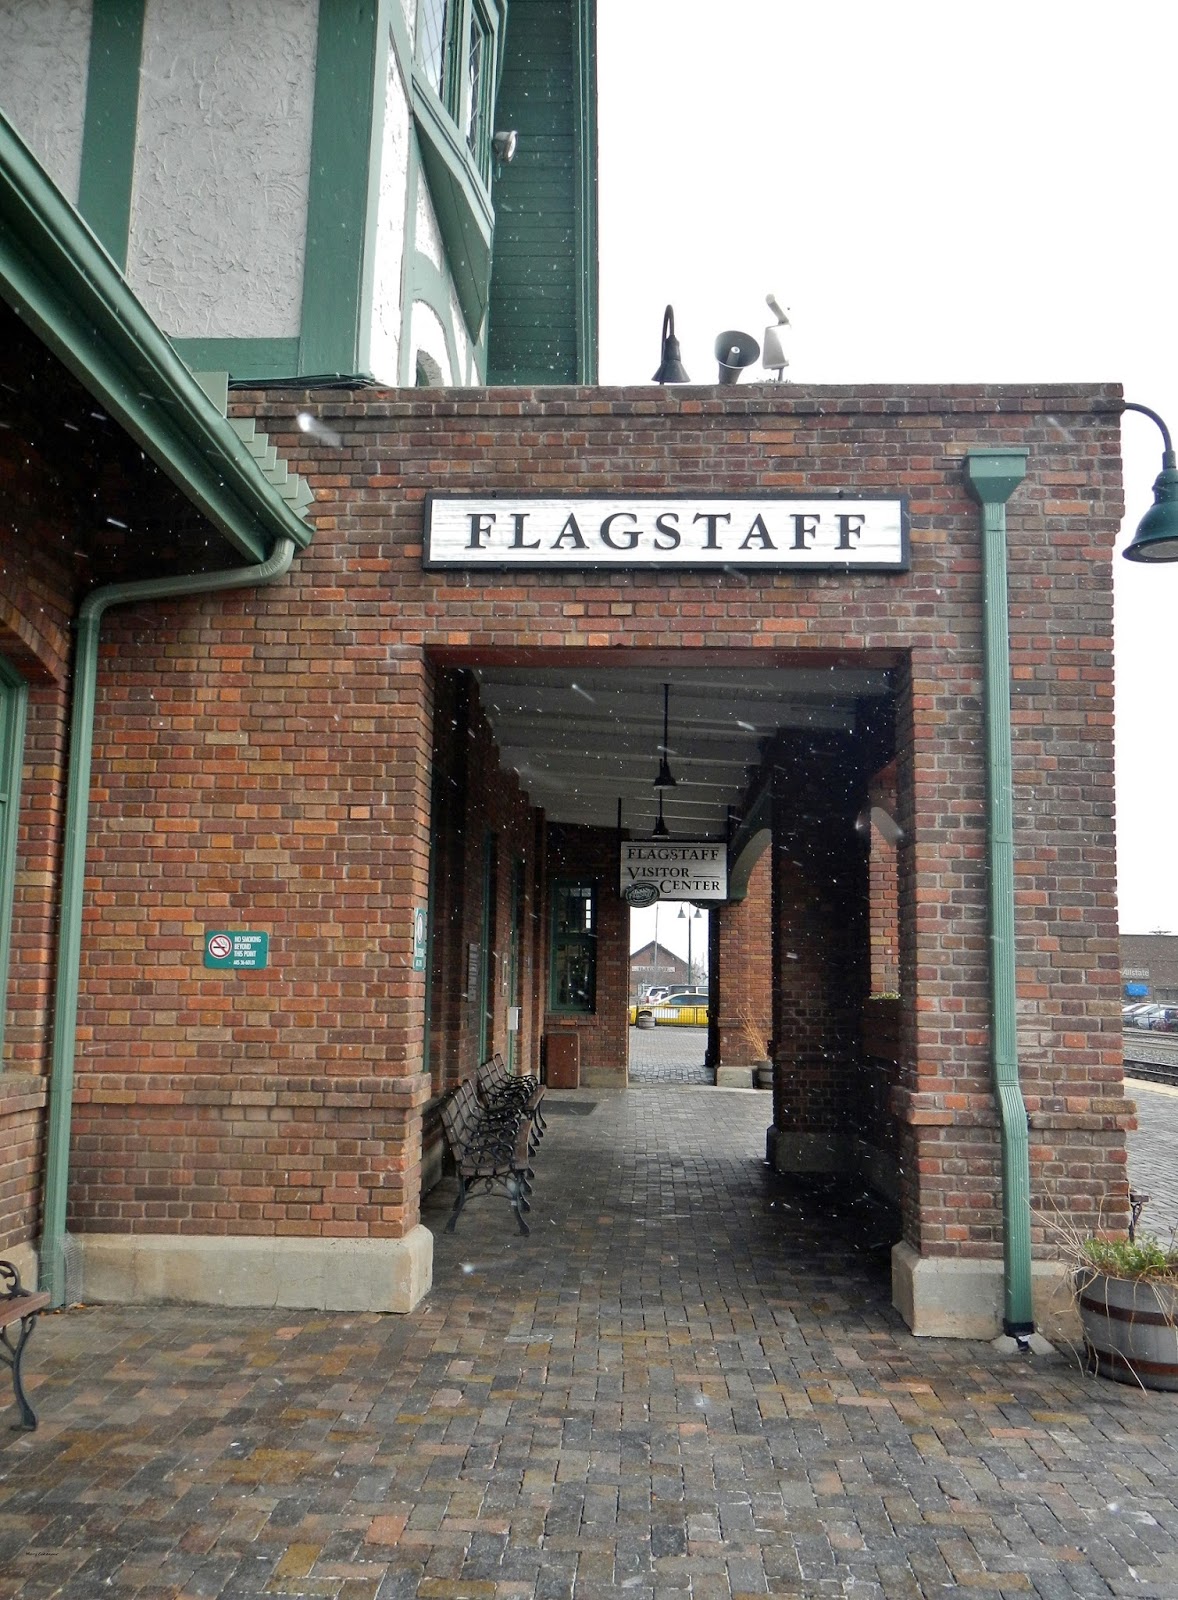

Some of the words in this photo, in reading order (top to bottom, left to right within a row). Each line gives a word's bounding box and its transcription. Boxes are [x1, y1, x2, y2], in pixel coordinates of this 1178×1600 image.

[464, 512, 866, 551] FLAGSTAFF
[627, 848, 720, 861] FLAGSTAFF
[627, 866, 690, 880] VISITOR
[660, 879, 720, 894] CENTER
[1122, 968, 1149, 977] Allstate
